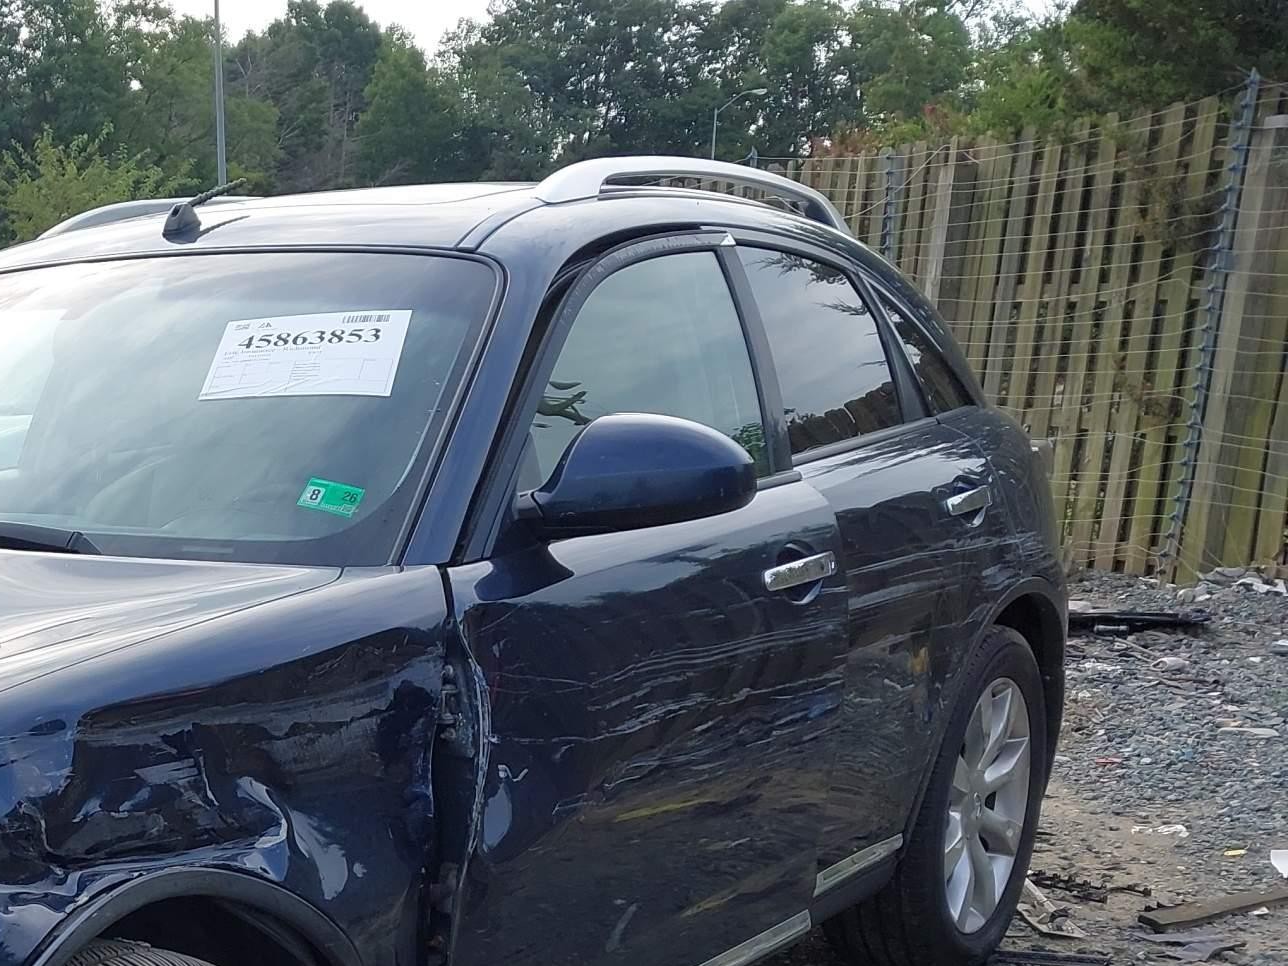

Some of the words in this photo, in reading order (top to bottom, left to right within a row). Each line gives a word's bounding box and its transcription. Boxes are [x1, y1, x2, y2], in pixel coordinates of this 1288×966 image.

[238, 328, 382, 349] 45863853
[309, 488, 322, 501] 8
[342, 490, 359, 504] 26
